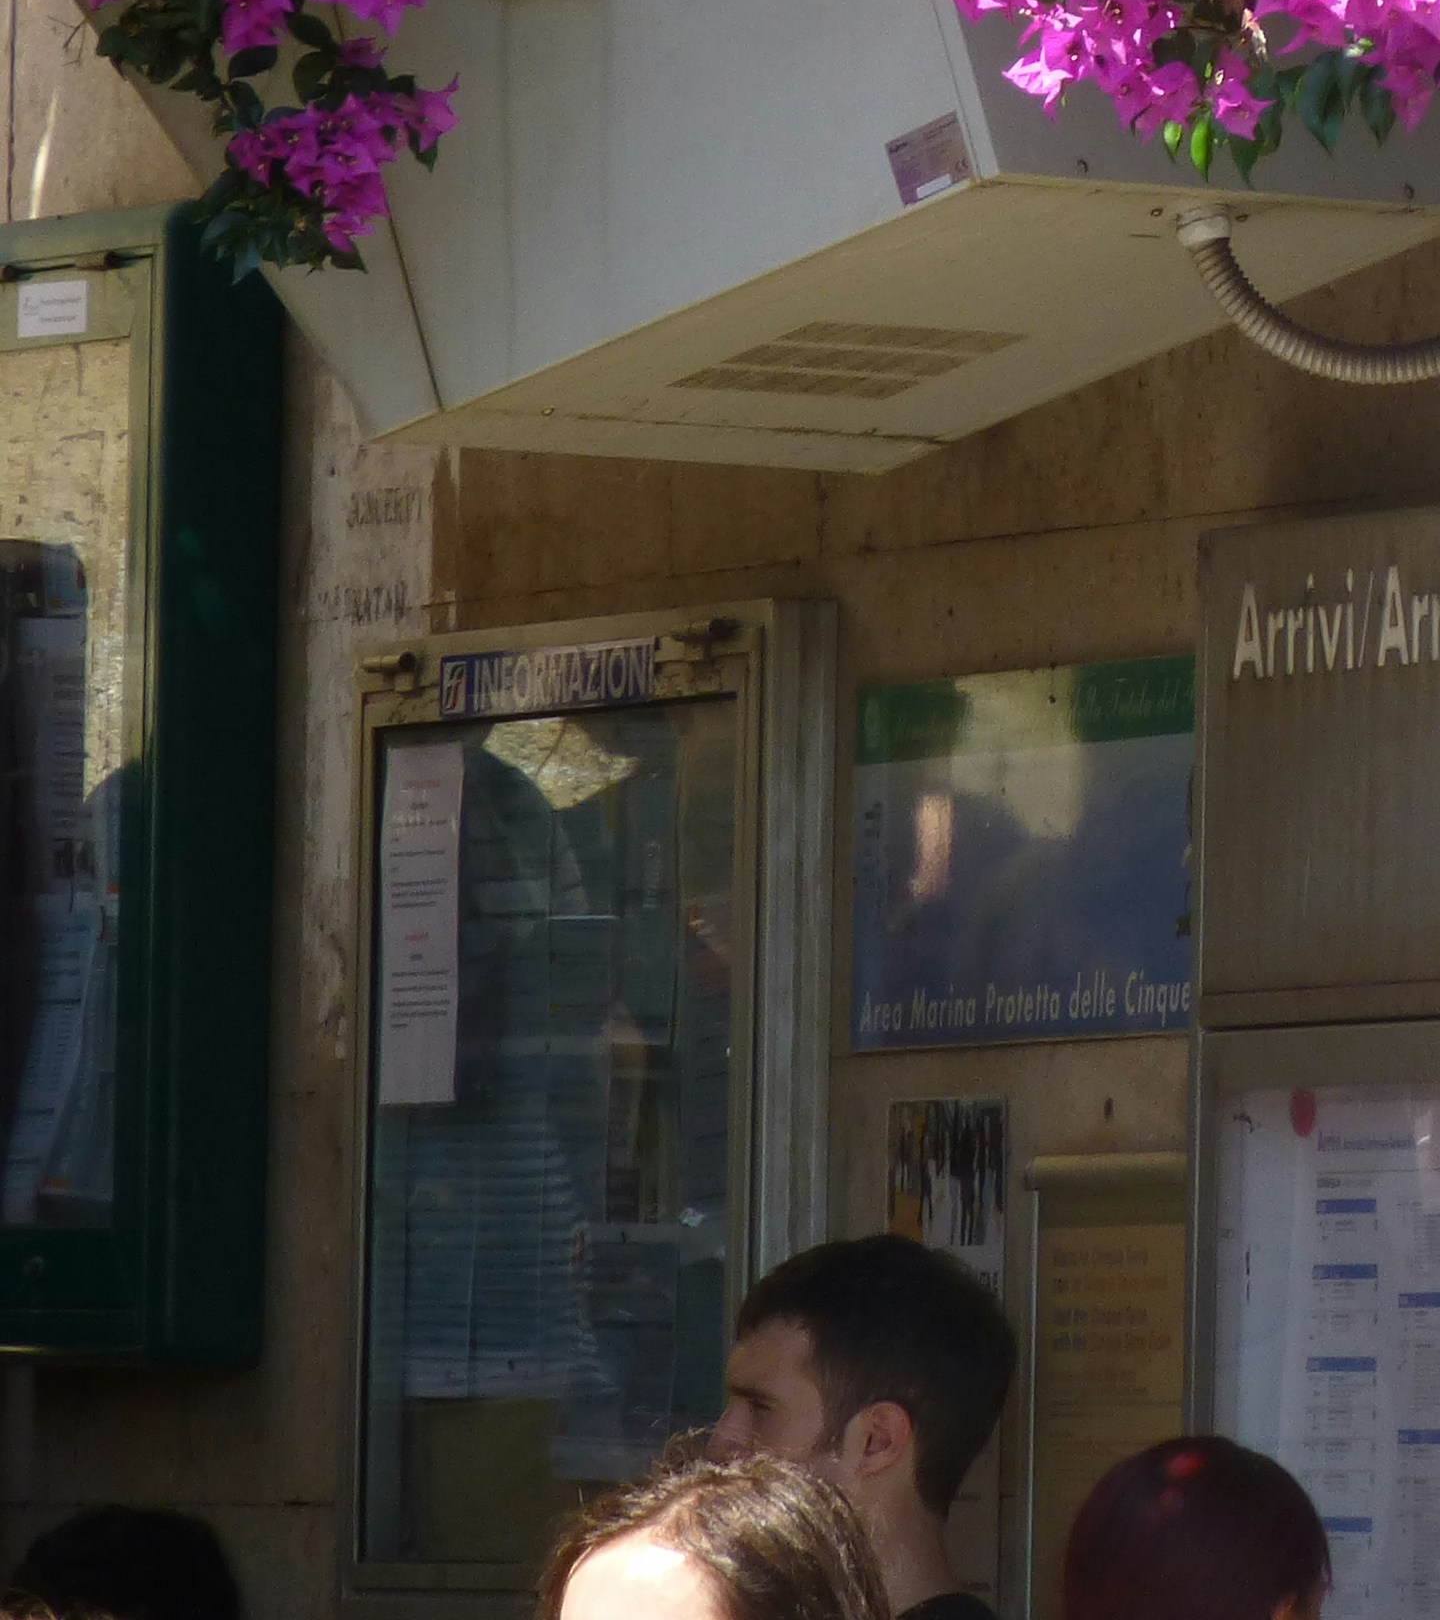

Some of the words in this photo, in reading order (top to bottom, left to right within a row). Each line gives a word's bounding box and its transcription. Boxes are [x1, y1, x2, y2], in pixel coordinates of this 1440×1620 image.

[473, 644, 655, 712] INFORMAZIONI
[859, 991, 902, 1033] Area
[910, 984, 976, 1030] Marina
[985, 982, 1060, 1025] Protetta
[1068, 970, 1116, 1019] delle
